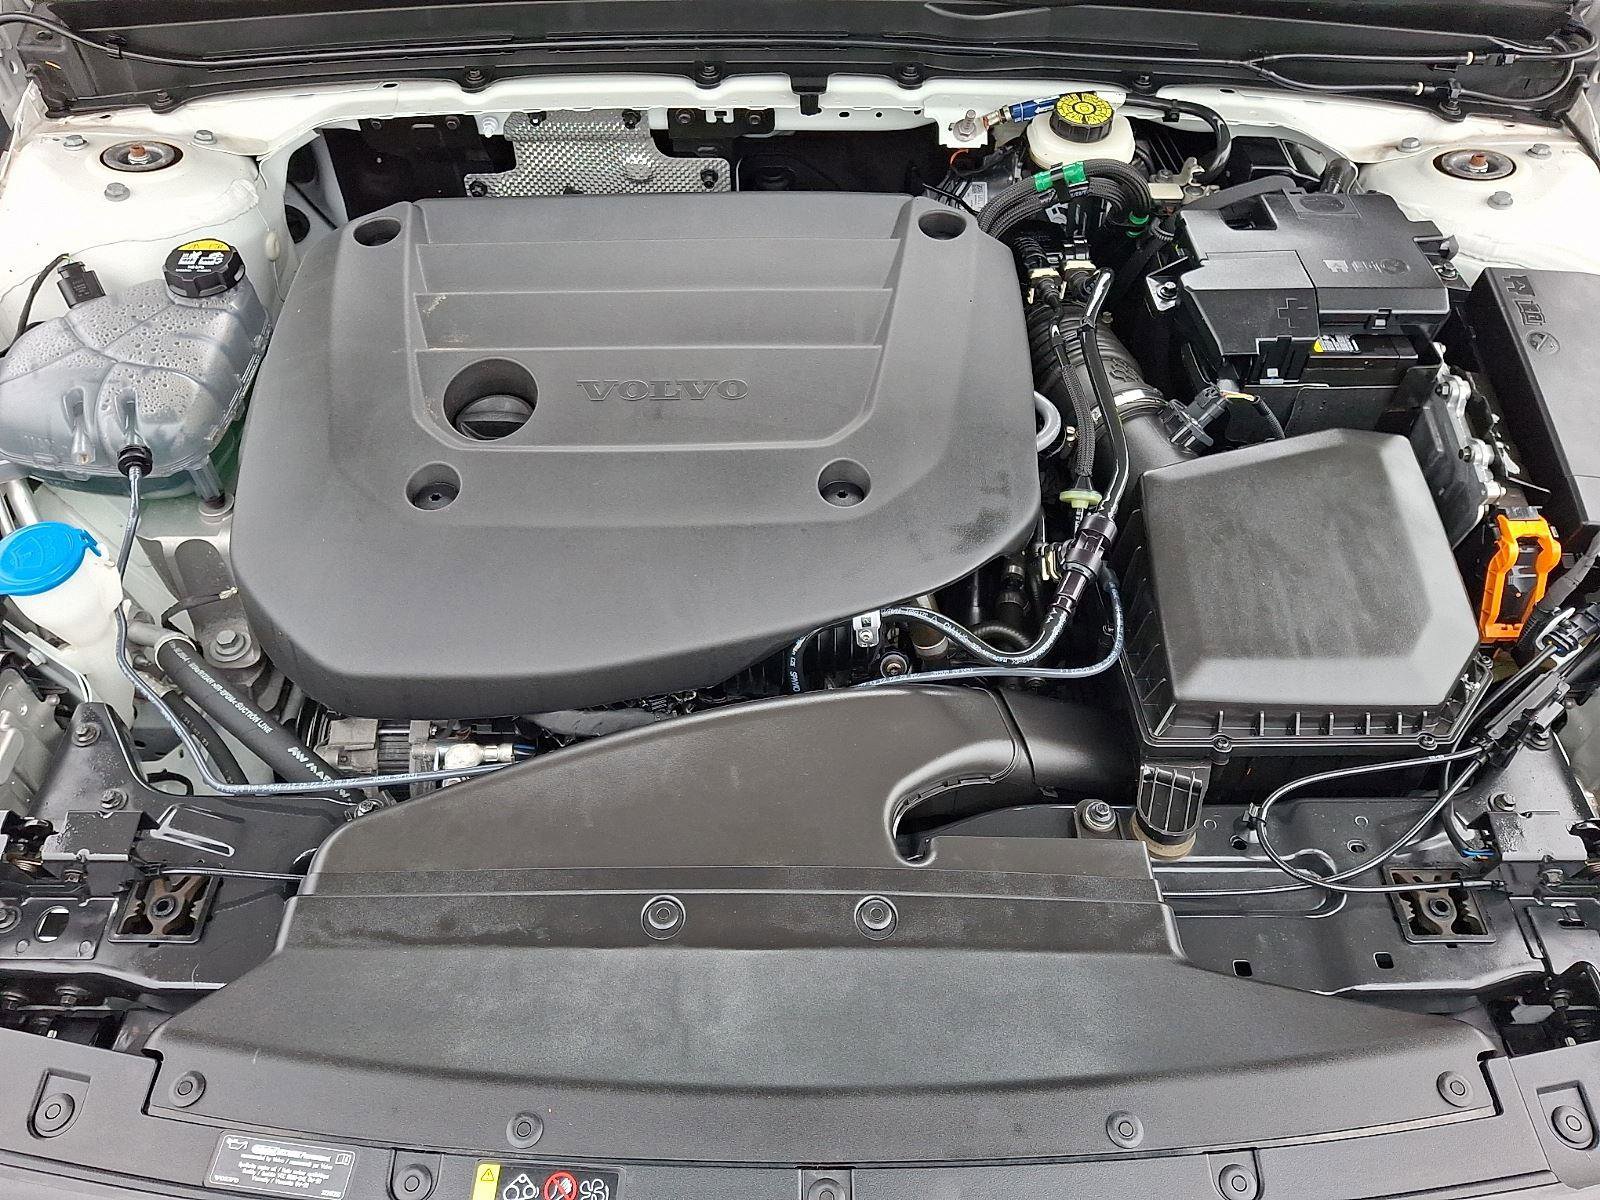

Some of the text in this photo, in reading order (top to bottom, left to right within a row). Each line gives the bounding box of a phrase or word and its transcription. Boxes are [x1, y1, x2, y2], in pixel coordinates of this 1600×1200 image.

[576, 379, 749, 401] VOLVO
[235, 702, 261, 724] SUCTION
[257, 718, 274, 734] LINE
